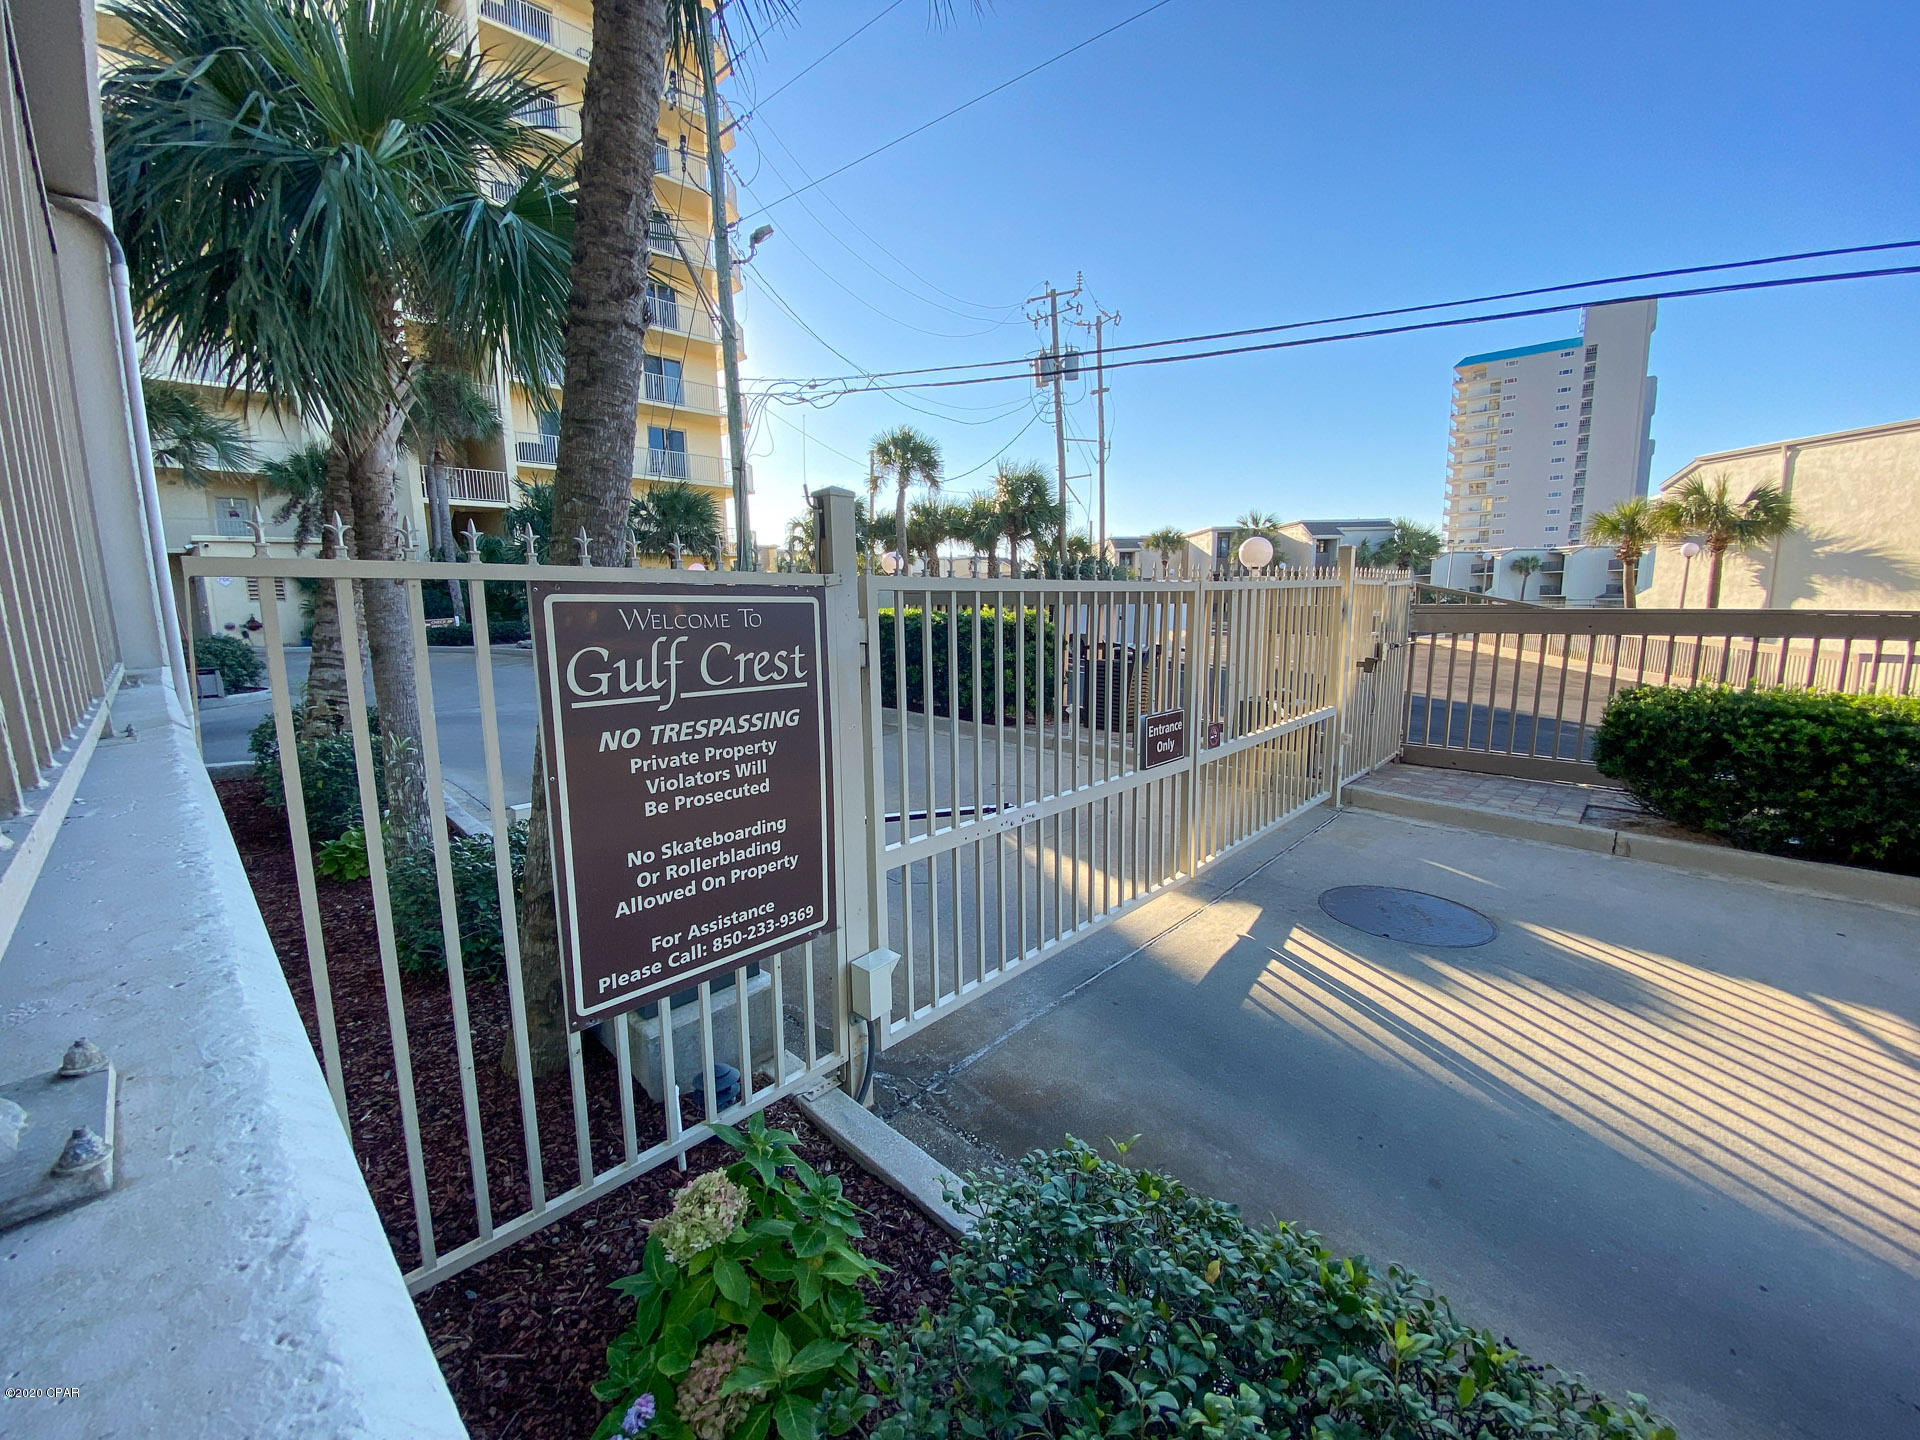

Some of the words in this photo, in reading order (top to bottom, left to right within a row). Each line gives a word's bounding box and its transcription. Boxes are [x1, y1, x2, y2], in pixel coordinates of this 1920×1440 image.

[566, 636, 688, 711] Gulf
[700, 642, 807, 686] Crest
[599, 729, 640, 752] NO
[651, 709, 800, 745] TRESPASSING
[1148, 721, 1182, 737] Entrance
[1156, 738, 1175, 753] Only
[630, 751, 699, 773] Private
[705, 739, 777, 765] Property
[646, 768, 730, 794] Violators
[735, 760, 766, 776] Will
[644, 800, 668, 816] Be
[674, 779, 769, 811] Prosecuted
[627, 850, 655, 867] No
[661, 818, 787, 860] Skateboarding
[636, 870, 659, 888] Or
[666, 839, 781, 882] Rollerblading
[615, 882, 696, 918] Allowed
[701, 875, 726, 892] On
[731, 854, 799, 887] Property
[598, 961, 662, 993] Please
[668, 944, 708, 968] Call:
[713, 906, 814, 952] 850-233-9369
[651, 935, 682, 952] For
[687, 901, 775, 941] Assistance
